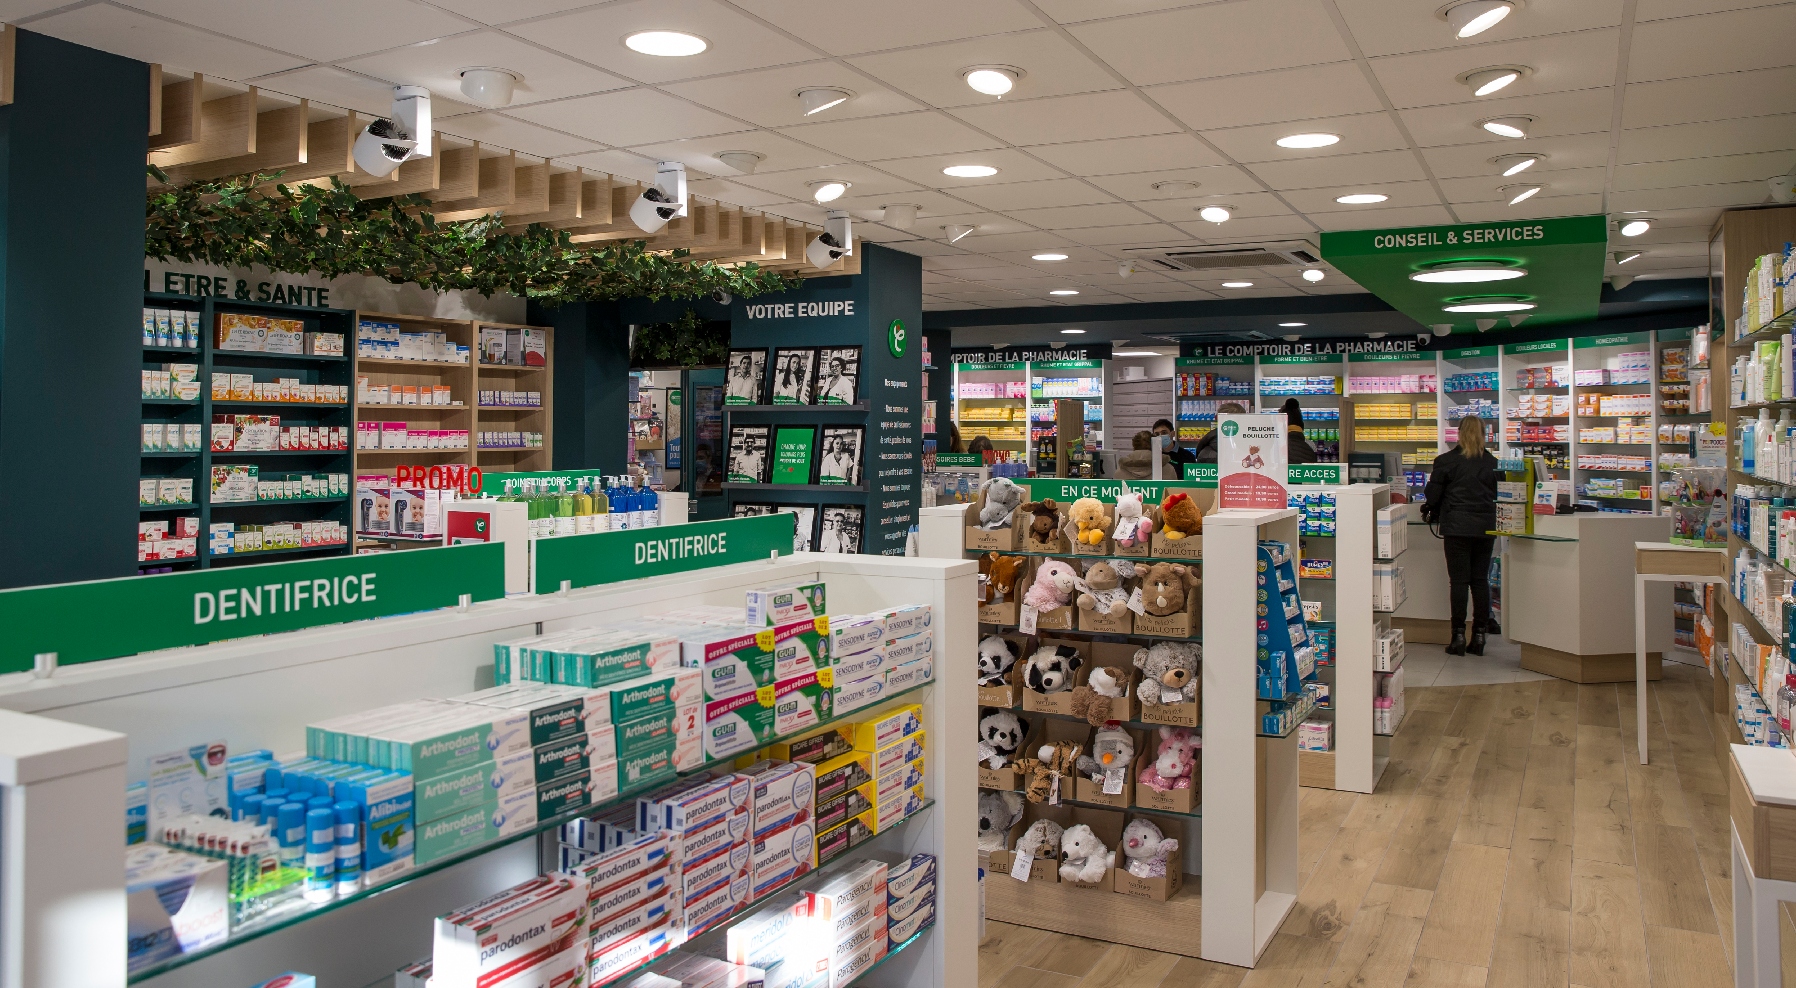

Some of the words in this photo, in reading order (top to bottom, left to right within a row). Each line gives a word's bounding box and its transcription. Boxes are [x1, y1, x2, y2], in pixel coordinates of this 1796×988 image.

[1374, 232, 1442, 249] CONSEIL
[1446, 232, 1459, 245] &
[1462, 226, 1544, 244] SERVICES
[165, 272, 228, 298] ETRE
[234, 279, 250, 302] &
[258, 282, 330, 308] SANTE
[746, 303, 795, 320] VOTRE
[798, 300, 855, 318] EQUIPE
[988, 352, 1003, 362] DE
[1006, 352, 1020, 362] LA
[1022, 350, 1088, 362] PHARMACIE
[1208, 346, 1224, 357] LE
[1226, 344, 1291, 357] COMPTOIR
[1294, 344, 1314, 355] DE
[1316, 343, 1334, 354] LA
[1336, 340, 1417, 354] PHARMACIE
[1538, 342, 1556, 350] LOCALES
[396, 464, 482, 494] PROMO
[1187, 468, 1218, 478] MEDICA
[1304, 468, 1336, 478] ACCES
[1061, 486, 1078, 497] EN
[1082, 486, 1098, 497] CE
[634, 532, 728, 566] DENTIFRICE
[1153, 548, 1202, 557] BOUILLOTTE
[193, 572, 378, 626] DENTIFRICE
[776, 594, 792, 604] GUM
[775, 629, 790, 642] OFFRE
[791, 622, 813, 637] SPÉCIALE
[889, 619, 913, 630] SENSODYNE
[1135, 625, 1186, 635] BOUILLOTTE
[708, 646, 727, 659] OFFRE
[728, 638, 755, 653] SPÉCIALE
[839, 634, 865, 648] SENSODYNE
[596, 650, 641, 668] Arthrodont
[778, 647, 796, 659] GUM
[888, 646, 913, 659] SENSODYNE
[714, 665, 734, 678] GUM
[835, 662, 864, 676] SENSODYNE
[889, 671, 914, 685] SENSODYNE
[622, 684, 666, 704] Arthrodont
[775, 684, 792, 696] OFFRE
[792, 675, 815, 691] SPÉCIALE
[710, 704, 728, 718] OFFRE
[728, 694, 755, 710] SPÉCIALE
[780, 701, 797, 713] GUM
[837, 690, 864, 706] SENSODYNE
[535, 708, 576, 727] Arthrodont
[626, 718, 667, 738] Arthrodont
[687, 716, 696, 730] 2
[1143, 712, 1194, 724] BOUILLOTTE
[715, 722, 736, 737] GUM
[420, 732, 480, 759] Arthrodont
[539, 744, 581, 764] Arthrodont
[425, 770, 484, 800] Arthrodont
[541, 781, 582, 803] Arthrodont
[370, 802, 396, 821] Alibi
[686, 796, 727, 824] parodontax
[756, 795, 791, 817] parodontax
[424, 810, 485, 840] Arthrodont
[685, 829, 726, 857] parodontax
[756, 847, 790, 873] parodontax
[591, 857, 641, 888] parodontax
[687, 858, 728, 890] parodontax
[592, 886, 641, 920] parodontax
[836, 880, 873, 907] Parogencyl
[481, 896, 531, 920] parodontax
[688, 893, 728, 925] parodontax
[836, 902, 870, 931] Parogencyl
[592, 915, 642, 948] parodontax
[750, 914, 786, 948] meridol
[836, 926, 870, 956] Parogencyl
[480, 924, 546, 964] parodontax
[594, 944, 642, 979] parodontax
[836, 950, 871, 981] Parogencyl
